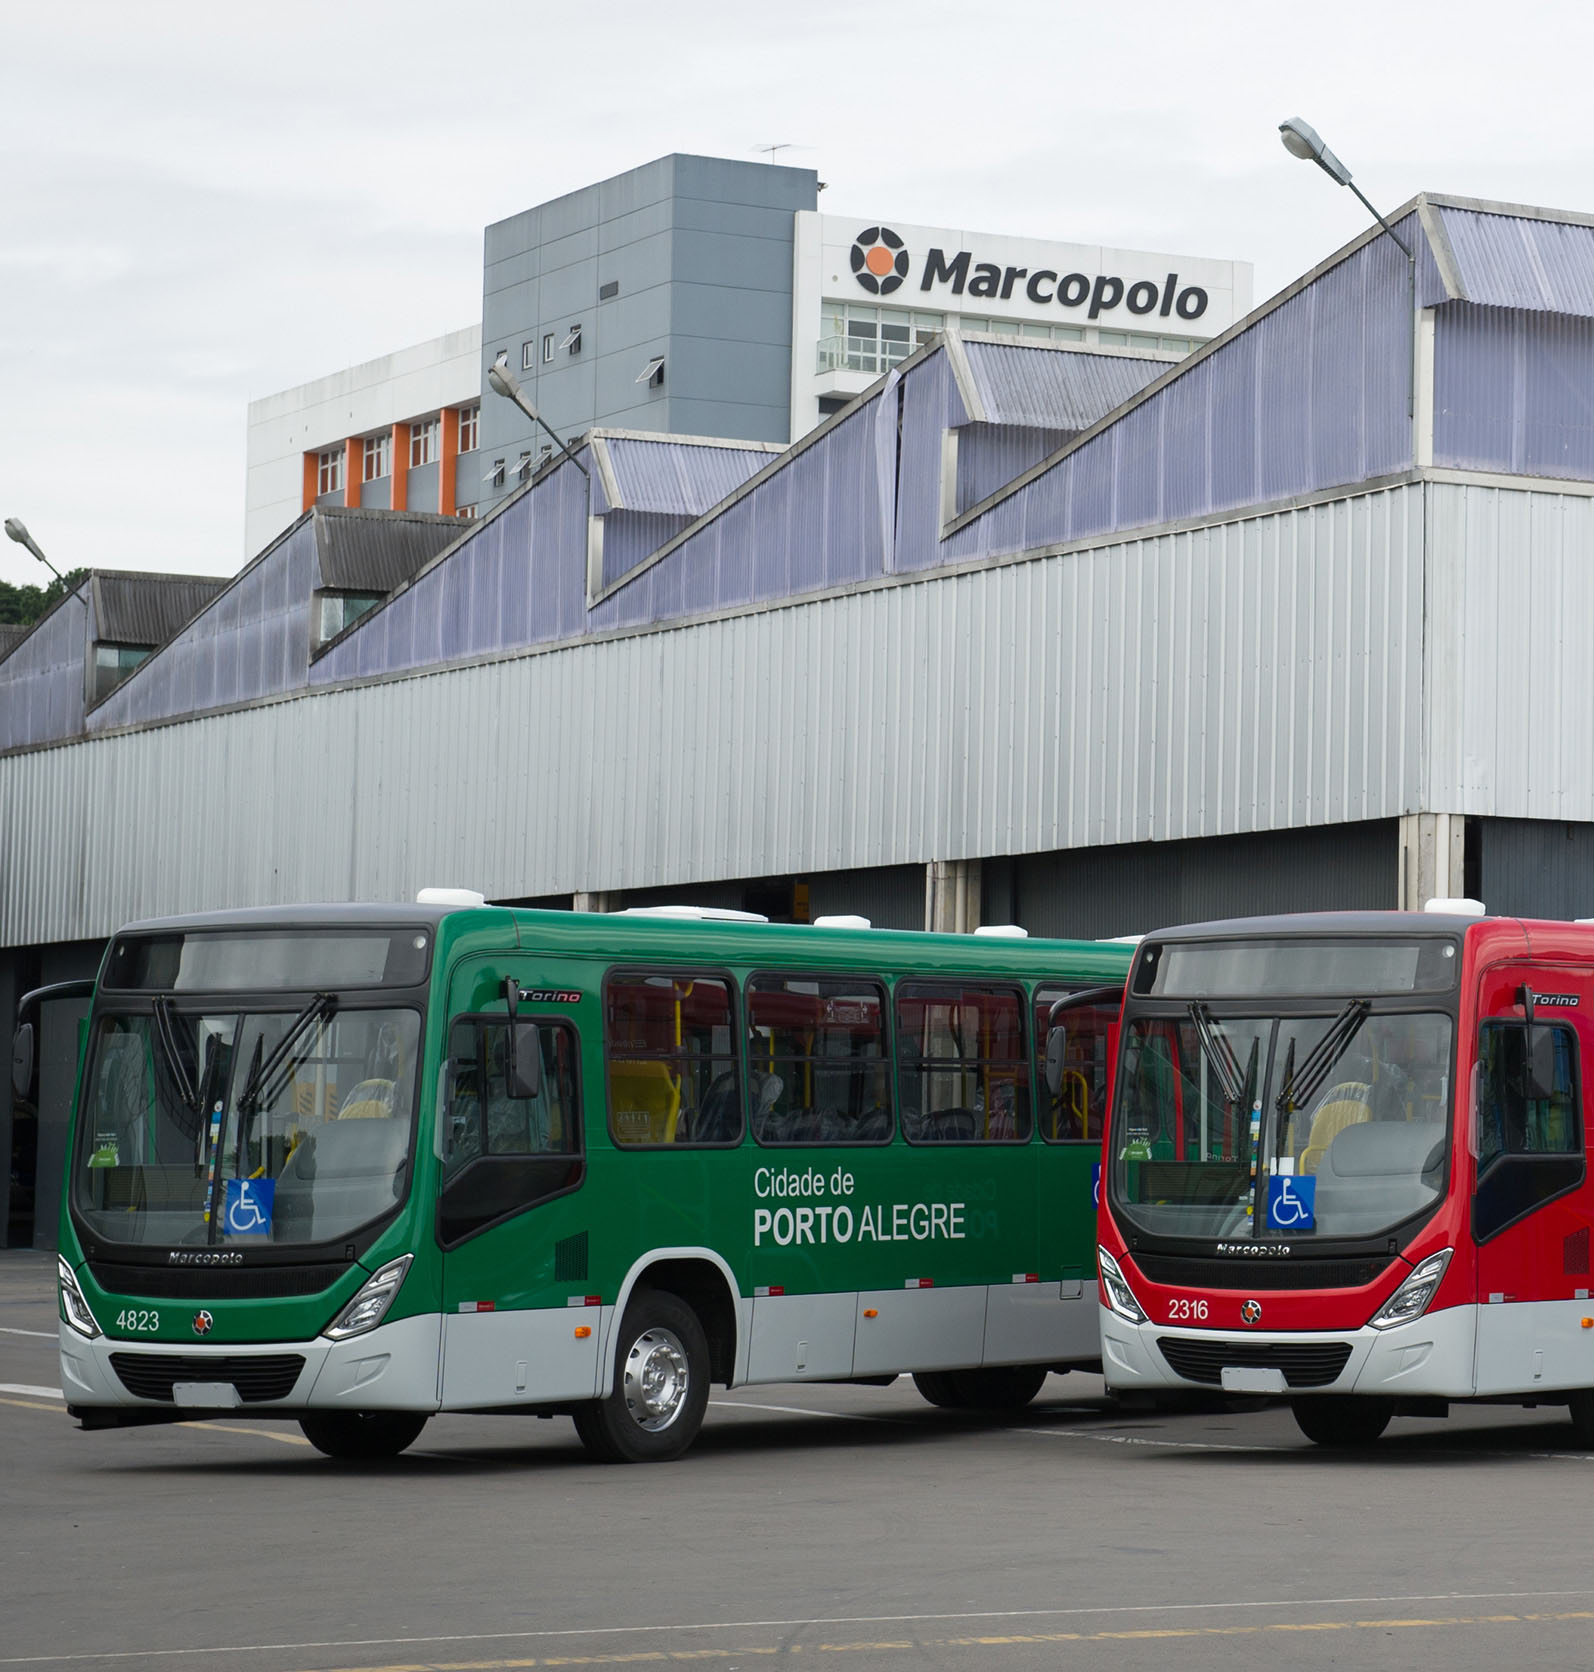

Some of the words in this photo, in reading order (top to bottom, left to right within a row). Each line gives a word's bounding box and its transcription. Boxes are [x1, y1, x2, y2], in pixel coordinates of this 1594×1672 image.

[920, 248, 1208, 320] Marcopolo
[519, 989, 581, 1002] Torino
[1531, 994, 1579, 1006] Torino
[754, 1167, 825, 1197] Cidade
[830, 1166, 854, 1195] de
[754, 1205, 853, 1246] PORTO
[857, 1203, 966, 1242] ALEGRE
[168, 1252, 243, 1264] Marcopolo
[1216, 1243, 1290, 1256] Marcopolo
[1168, 1299, 1208, 1319] 2316
[116, 1310, 159, 1331] 4823
